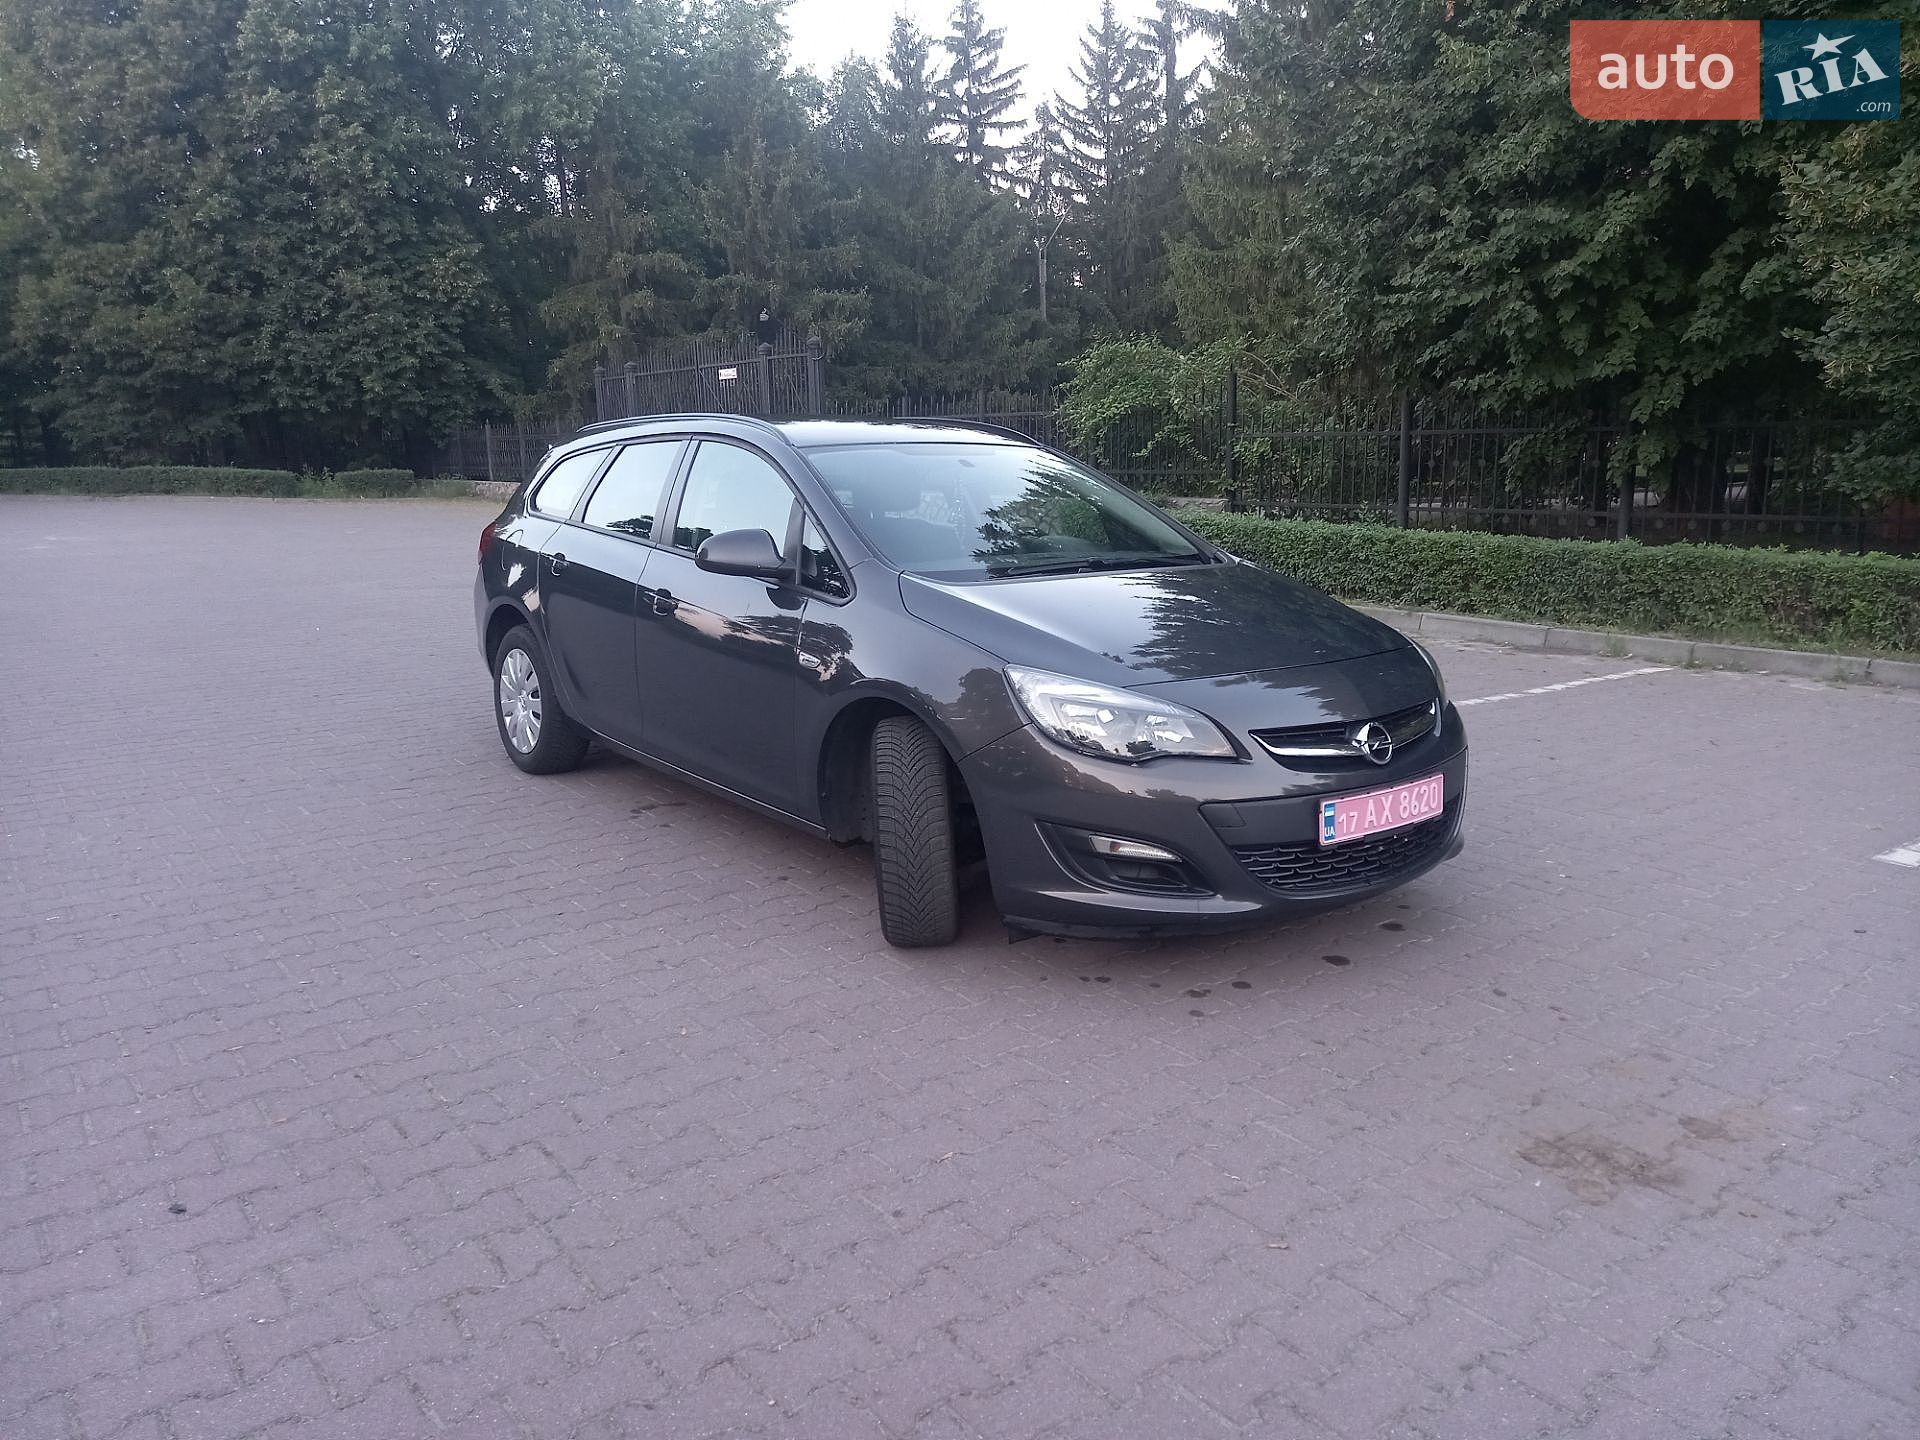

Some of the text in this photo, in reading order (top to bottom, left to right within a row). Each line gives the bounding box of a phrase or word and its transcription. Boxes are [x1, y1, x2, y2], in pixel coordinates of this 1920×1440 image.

[1338, 782, 1438, 833] 17 AX 8620
[1324, 827, 1336, 837] UA
